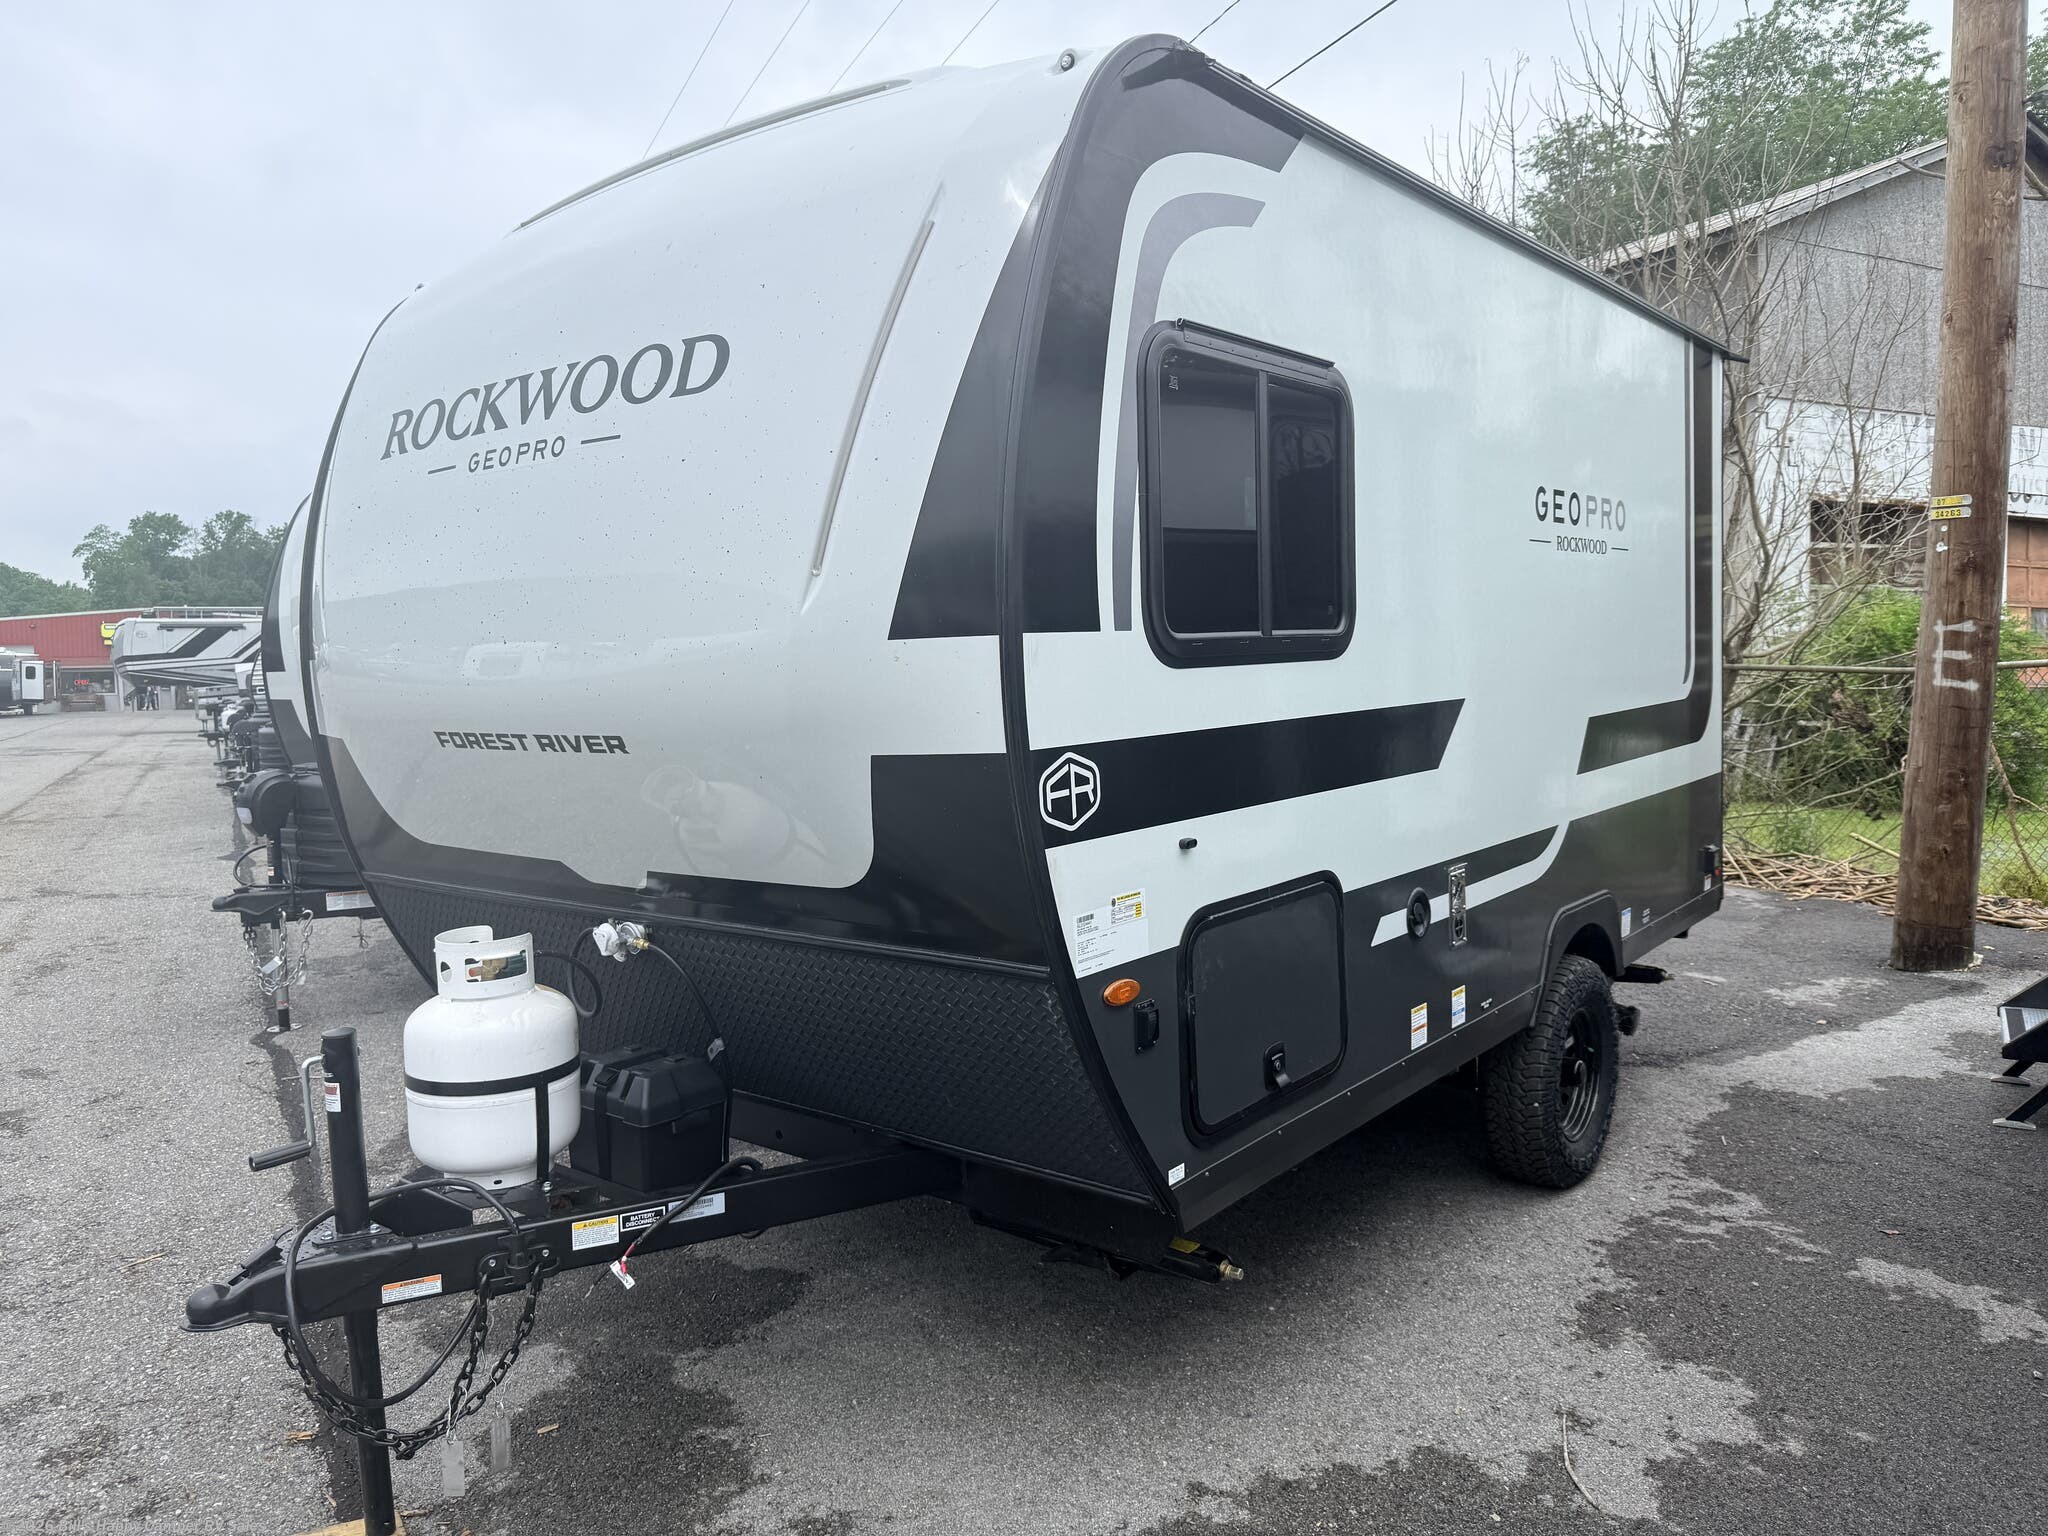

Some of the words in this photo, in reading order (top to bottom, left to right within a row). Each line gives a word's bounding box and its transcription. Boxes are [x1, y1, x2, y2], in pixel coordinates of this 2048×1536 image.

[380, 333, 731, 461] ROCKWOOD
[467, 435, 566, 473] GEOPRO
[1535, 485, 1626, 532] GEOPRO
[1556, 535, 1607, 554] ROCKWOOD
[433, 731, 528, 752] FOREST
[532, 734, 631, 755] RIVER
[630, 1212, 656, 1221] BATTERY
